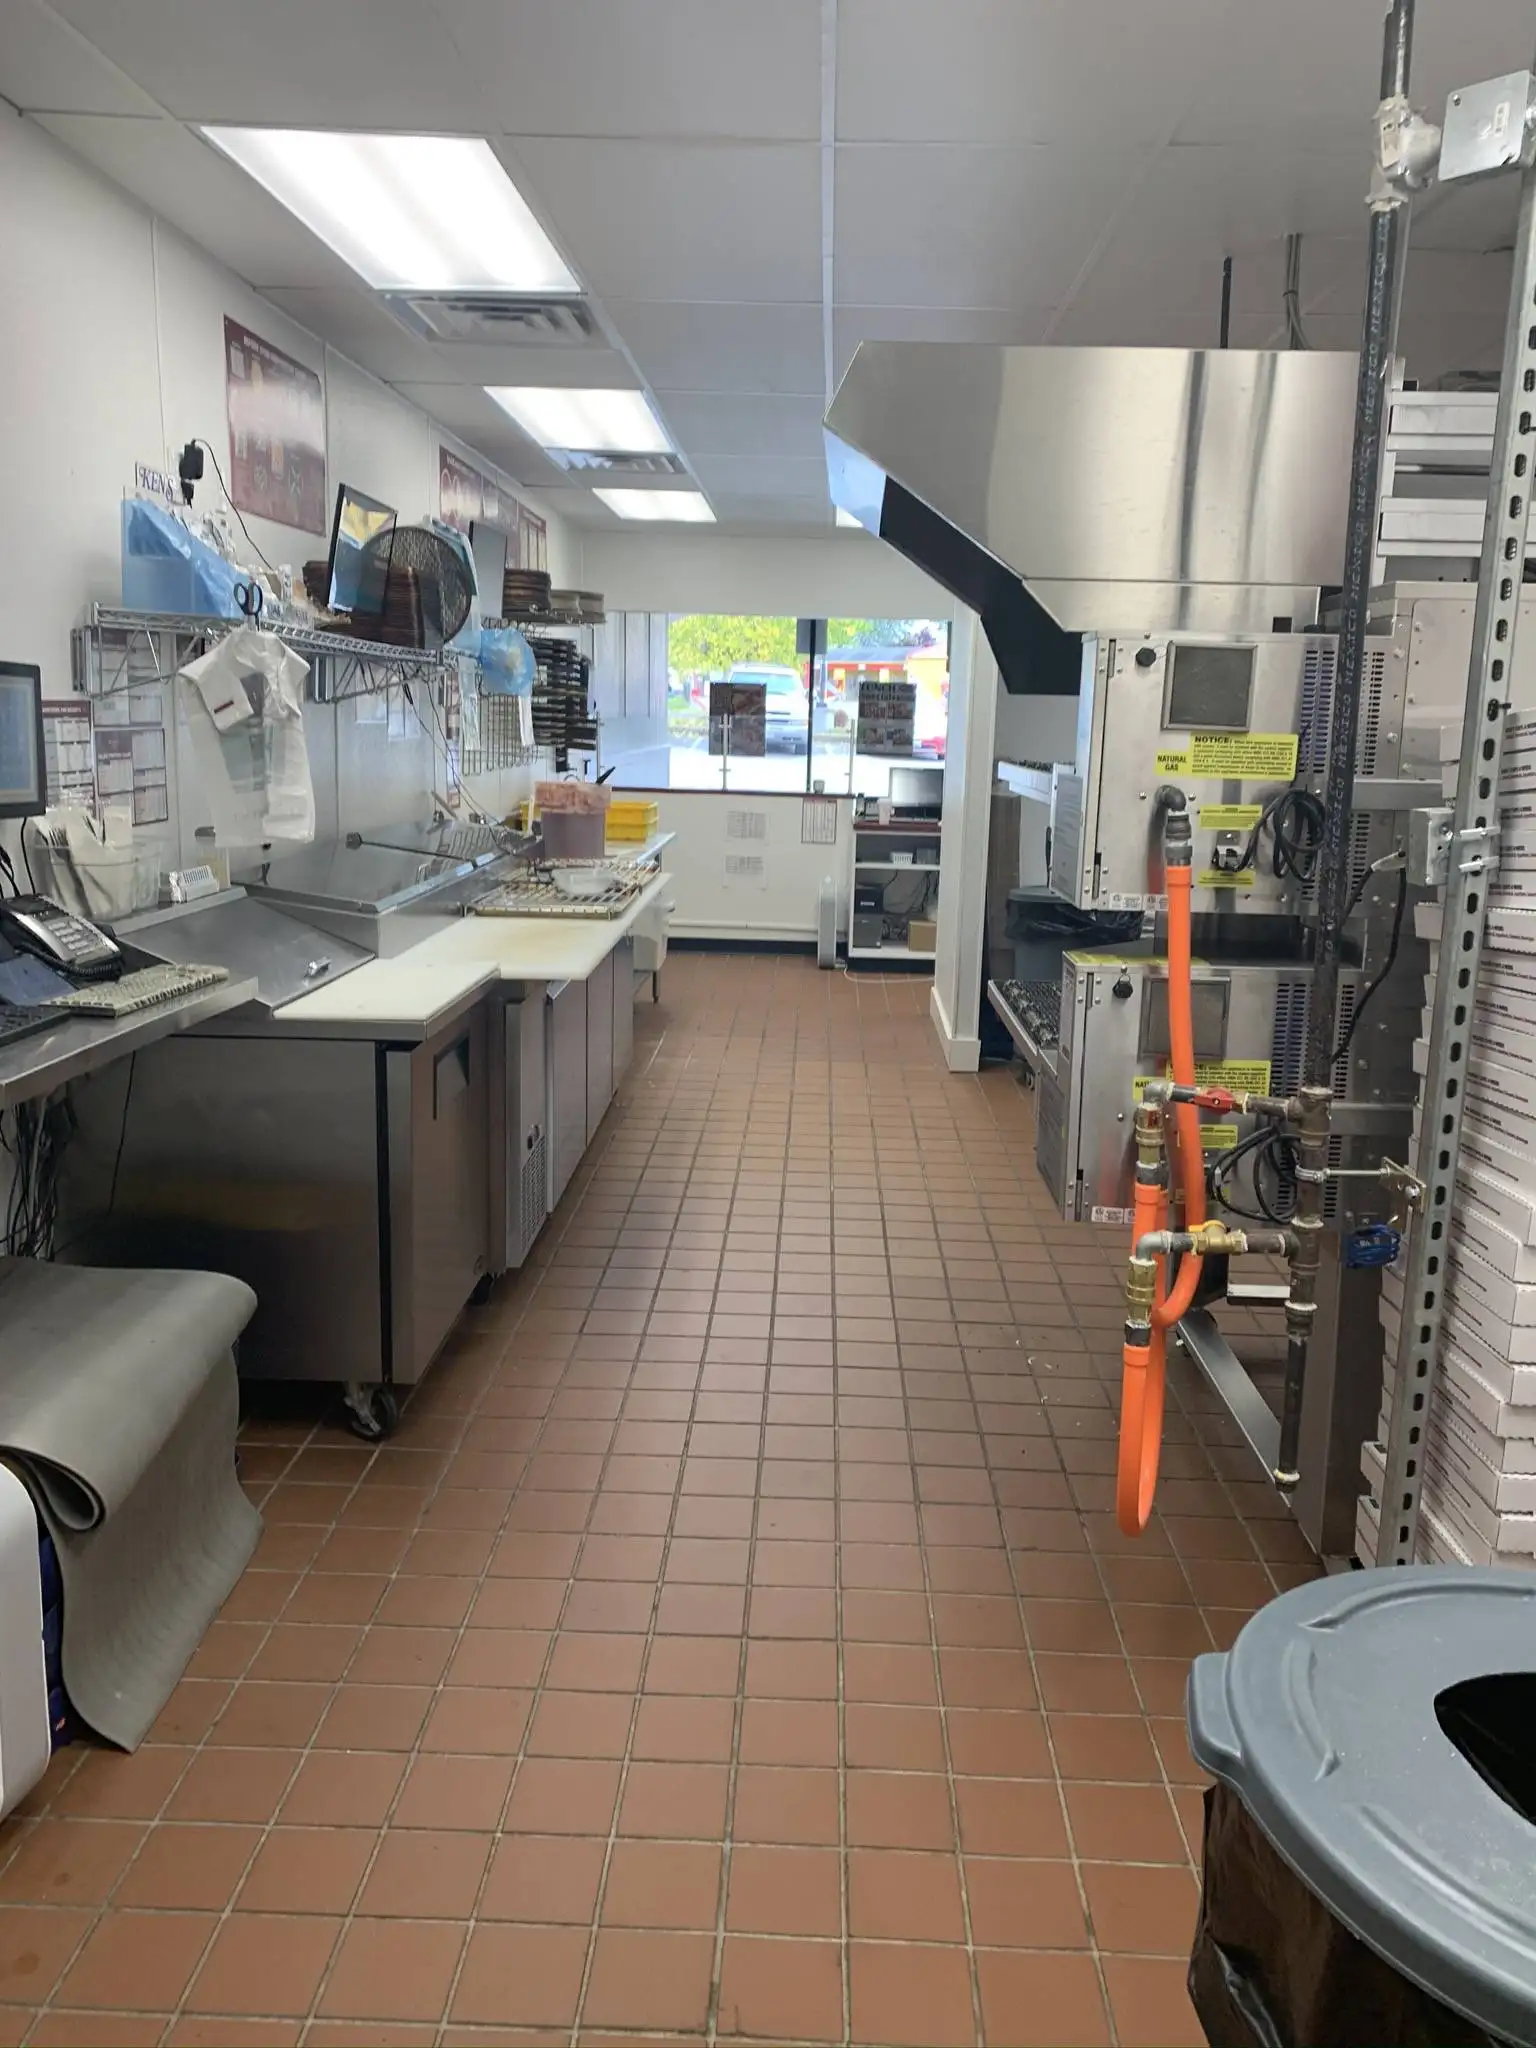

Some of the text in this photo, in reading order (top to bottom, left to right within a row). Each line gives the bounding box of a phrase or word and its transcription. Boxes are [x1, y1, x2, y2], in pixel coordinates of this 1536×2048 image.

[1337, 693, 1352, 768] MEXICO
[1345, 608, 1359, 685] MEXICO
[1371, 252, 1388, 333] MEXICO
[1194, 735, 1233, 744] NOTICE:
[1157, 755, 1187, 763] NATURAL
[1164, 763, 1179, 772] GAS
